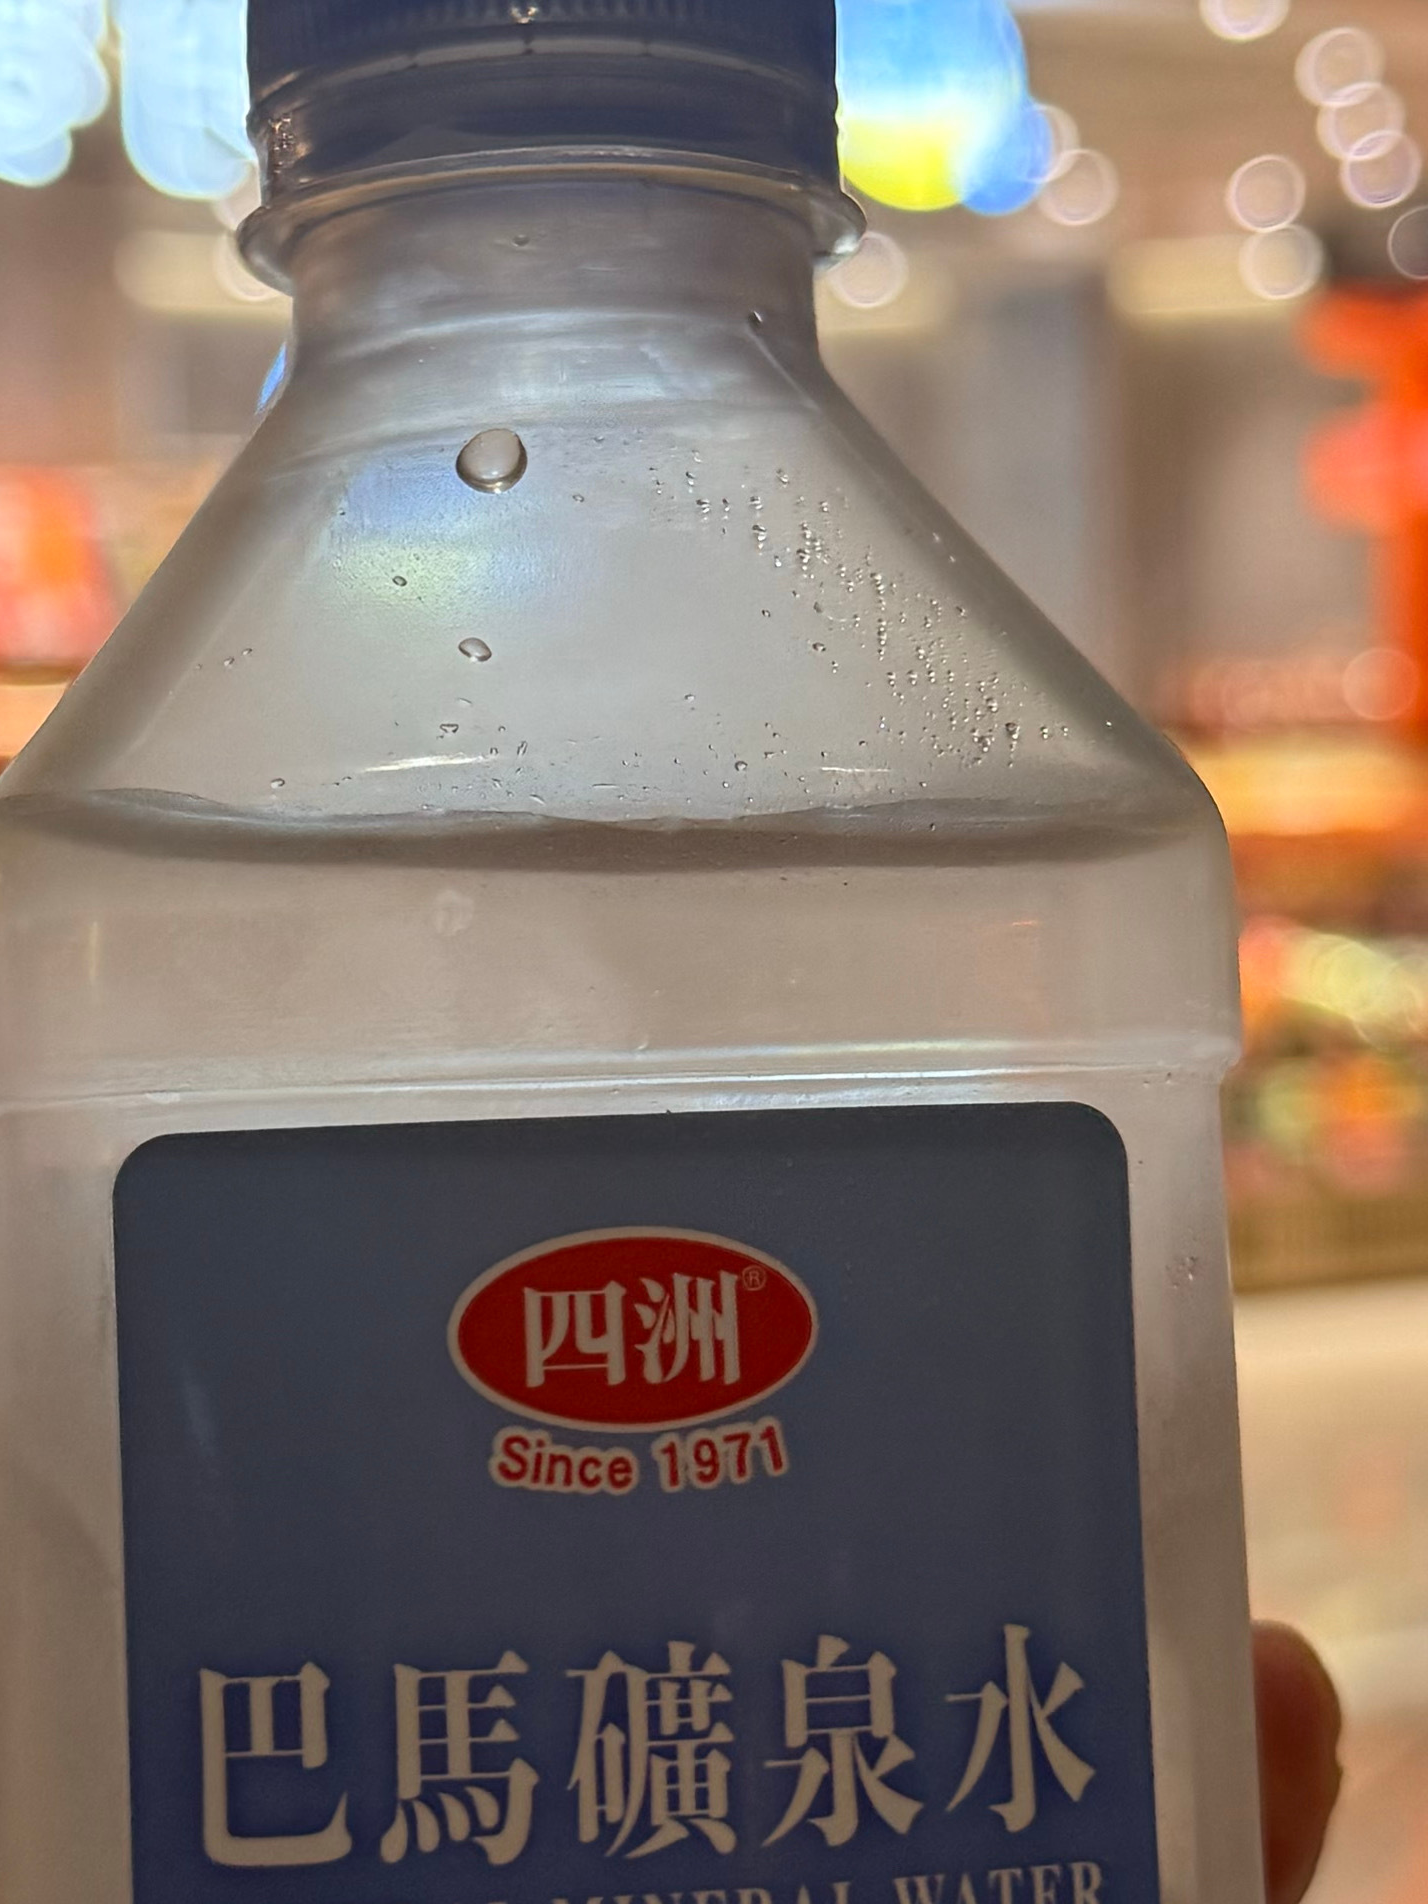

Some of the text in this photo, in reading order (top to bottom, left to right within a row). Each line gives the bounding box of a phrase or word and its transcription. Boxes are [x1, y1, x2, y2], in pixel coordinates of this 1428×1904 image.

[523, 1271, 741, 1389] 四洲
[496, 1425, 784, 1490] Since 1971
[199, 1624, 1096, 1867] 巴馬礦泉水
